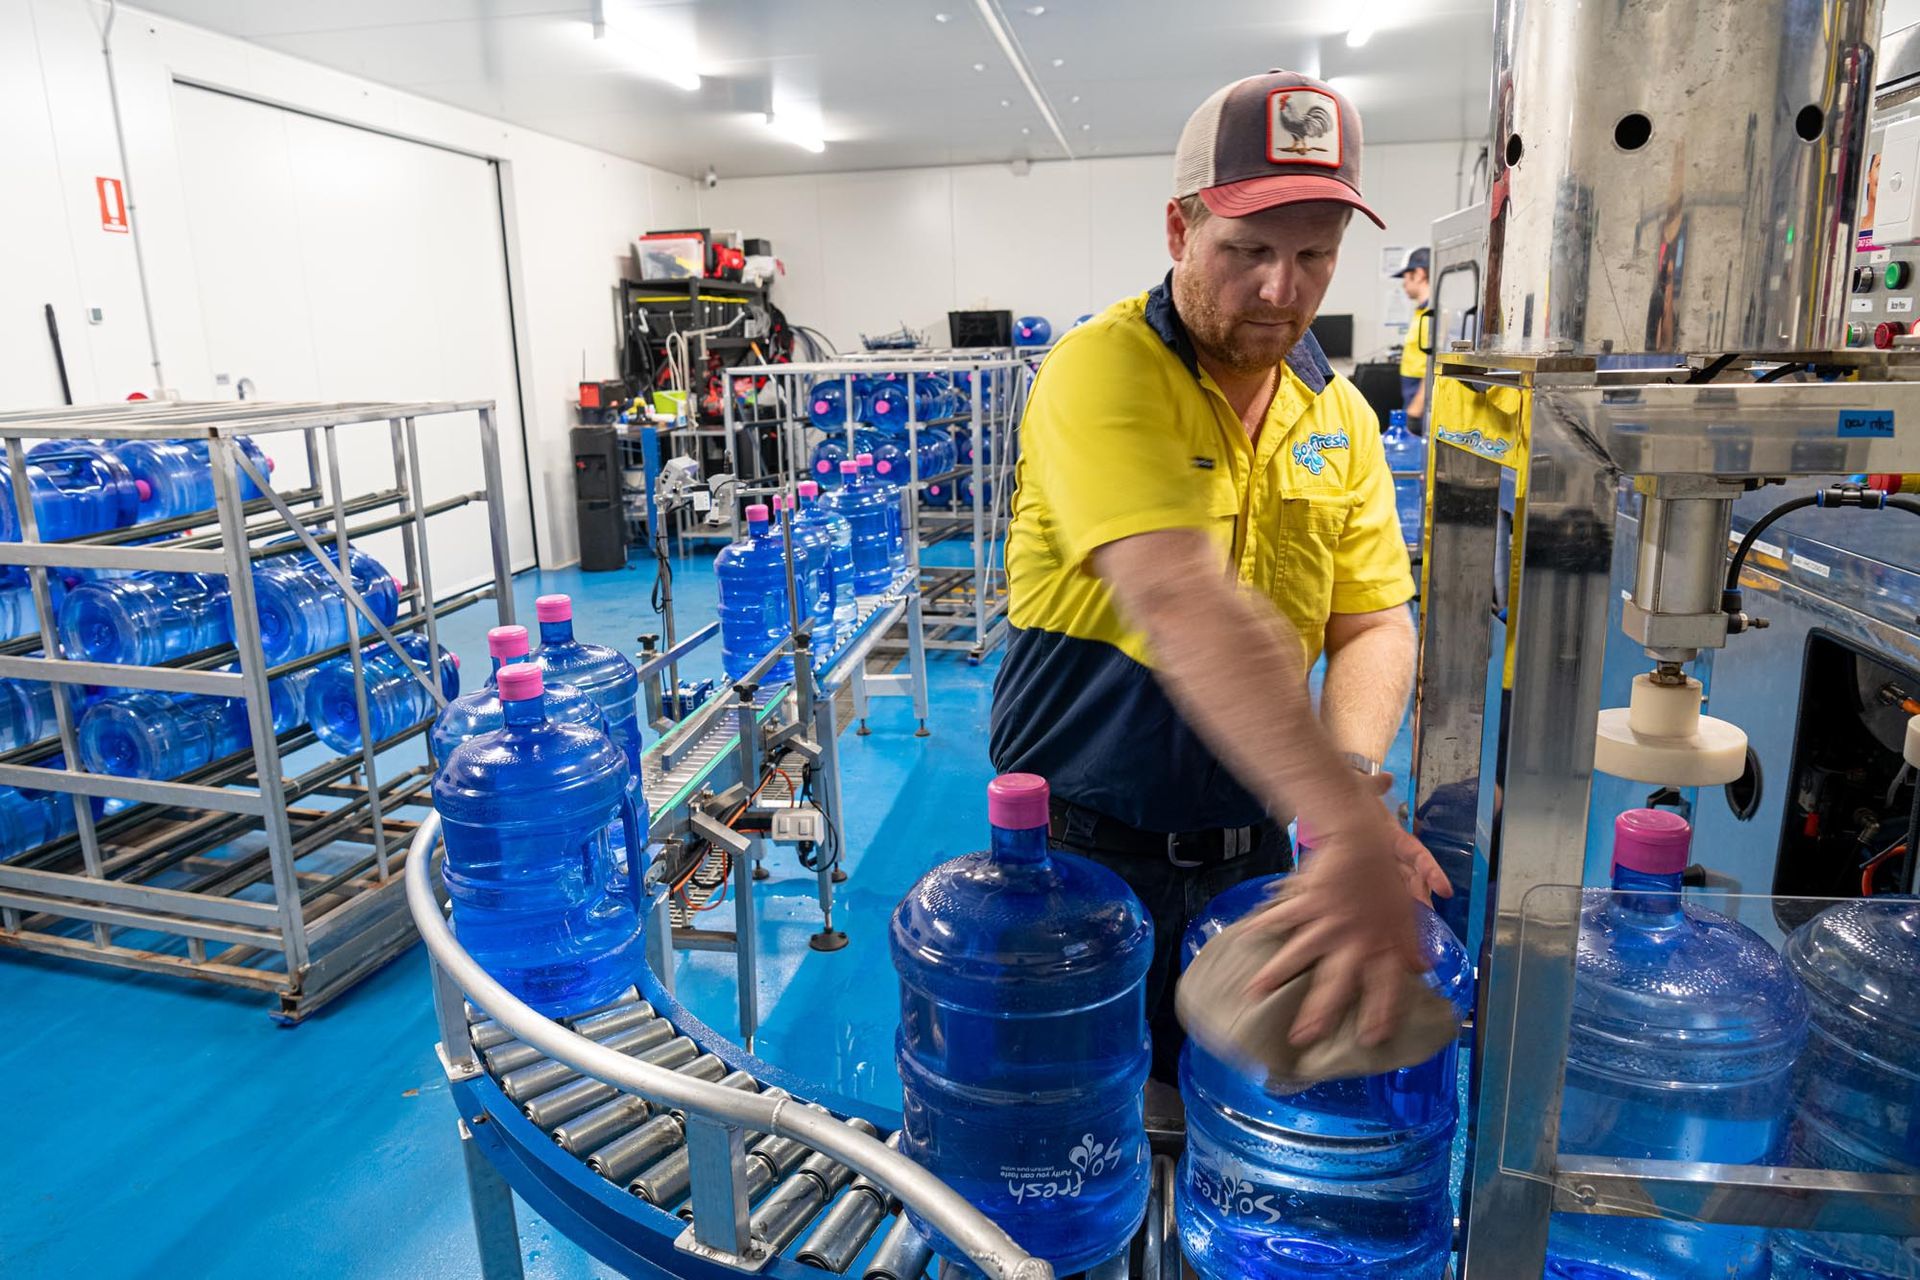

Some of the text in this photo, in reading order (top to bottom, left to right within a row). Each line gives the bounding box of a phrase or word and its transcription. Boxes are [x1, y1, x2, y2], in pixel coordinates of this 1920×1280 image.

[1309, 428, 1349, 451] fresh
[1000, 1171, 1019, 1179] taste
[1036, 1171, 1050, 1179] you
[1008, 1171, 1085, 1205] fresh
[1239, 1194, 1281, 1224] So
